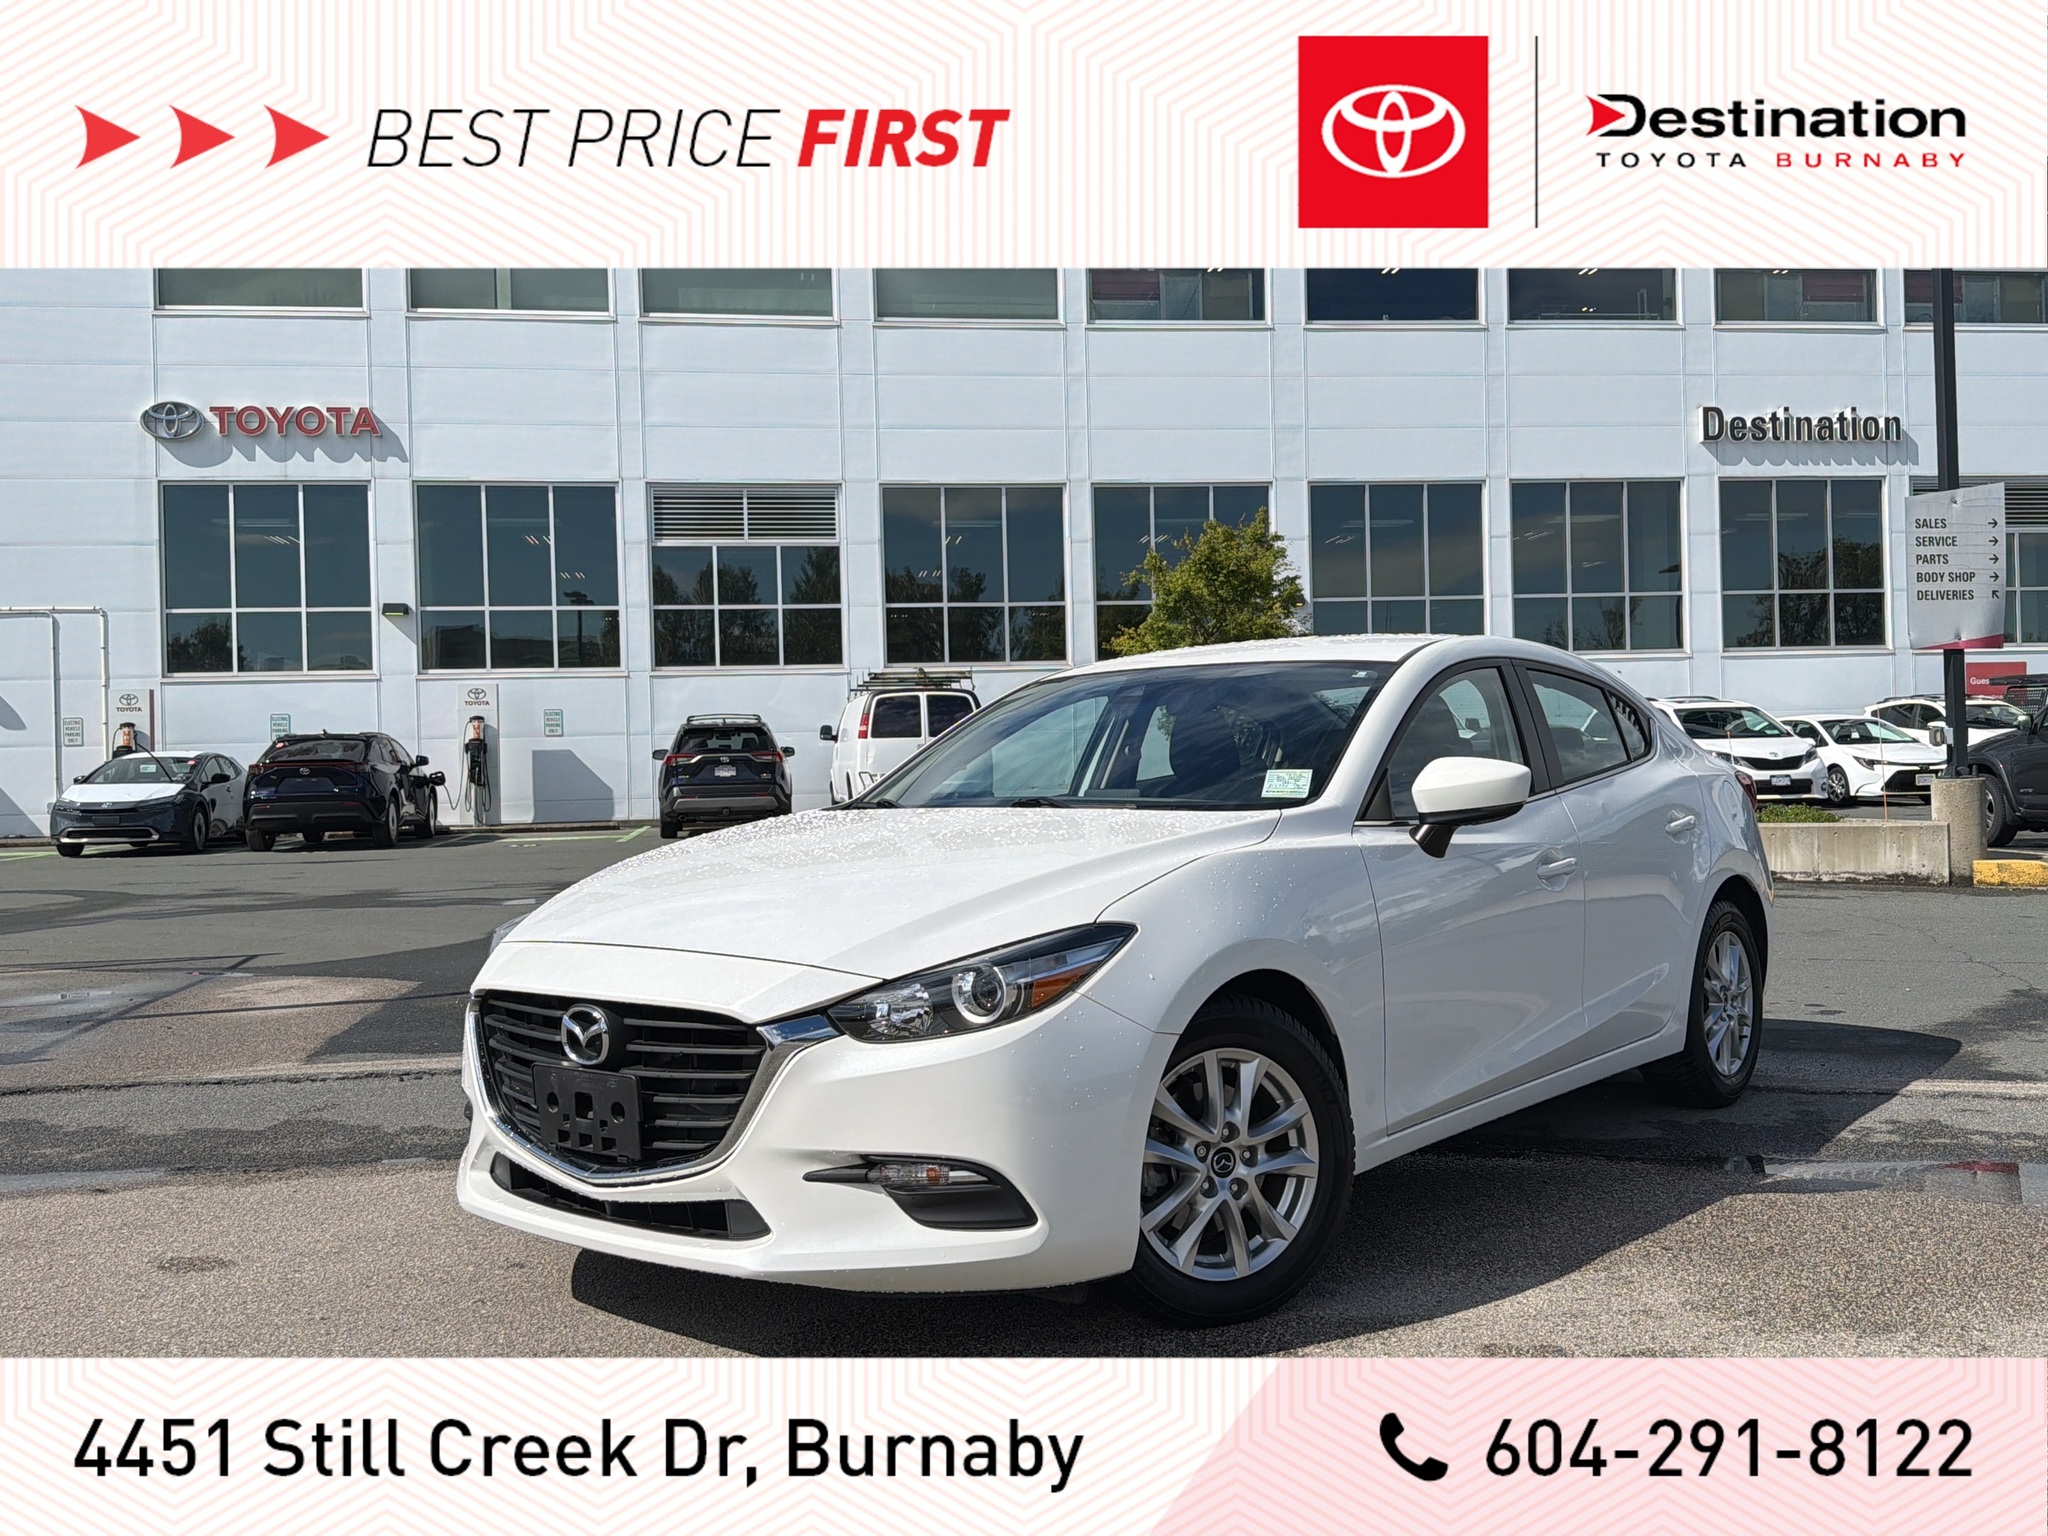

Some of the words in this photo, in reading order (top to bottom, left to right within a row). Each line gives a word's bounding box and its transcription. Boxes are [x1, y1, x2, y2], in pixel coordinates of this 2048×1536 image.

[209, 405, 382, 437] TOYOTA
[1701, 406, 1902, 442] Destination
[1914, 517, 1947, 529] SALES
[1915, 535, 1958, 547] SERVICE
[1915, 553, 1949, 565] PARTS
[1916, 571, 1945, 583] BODY
[1947, 571, 1976, 583] SHOP
[1916, 589, 1975, 601] DELIVERIES
[1969, 676, 1990, 685] Gues
